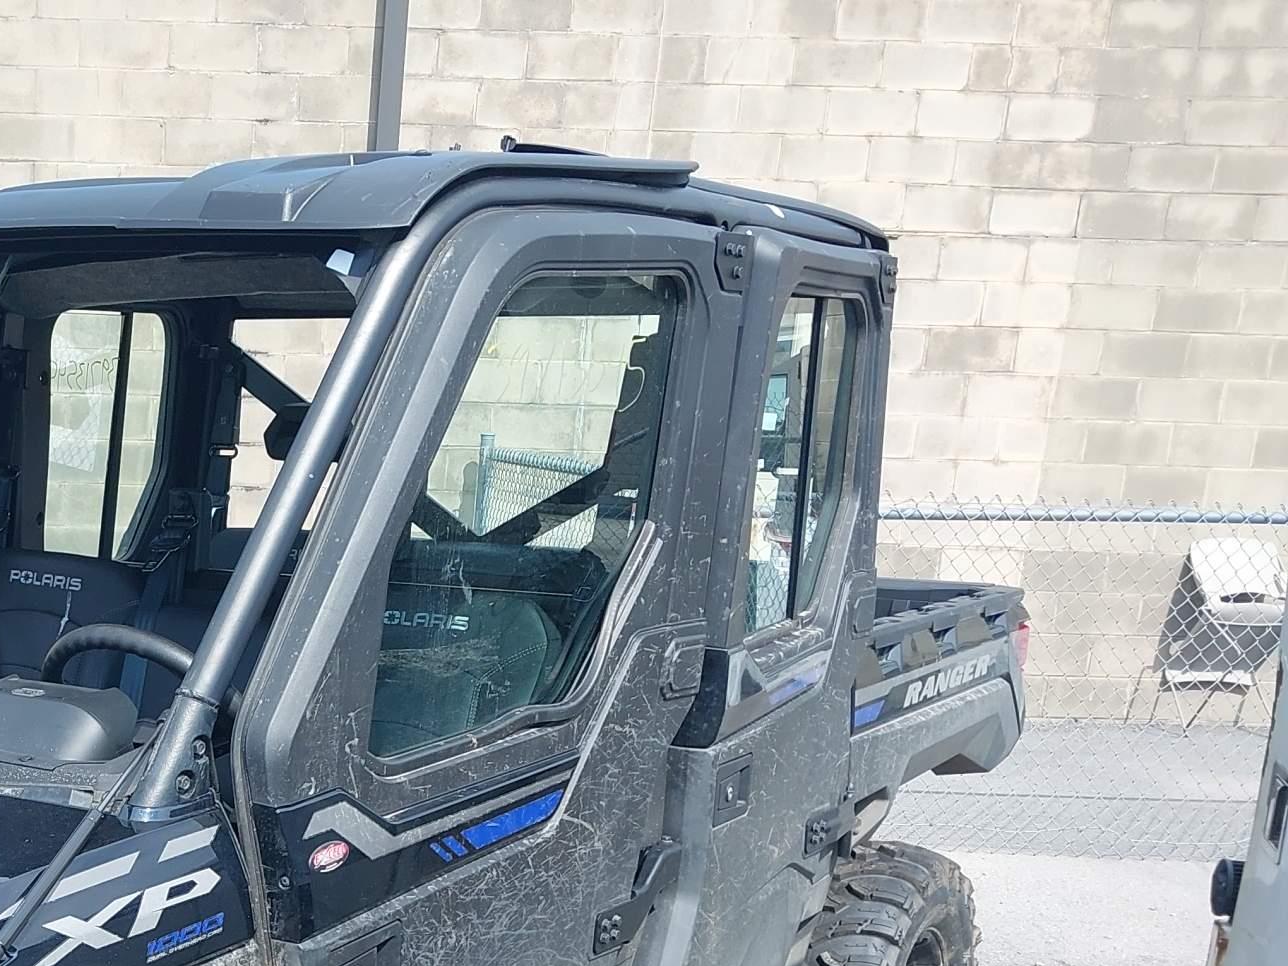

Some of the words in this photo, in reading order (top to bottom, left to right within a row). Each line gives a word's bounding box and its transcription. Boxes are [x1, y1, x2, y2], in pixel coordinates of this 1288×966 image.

[9, 569, 82, 591] POLARIS
[383, 610, 470, 632] OLARIS
[902, 654, 991, 709] RANGER
[146, 912, 225, 956] 1000
